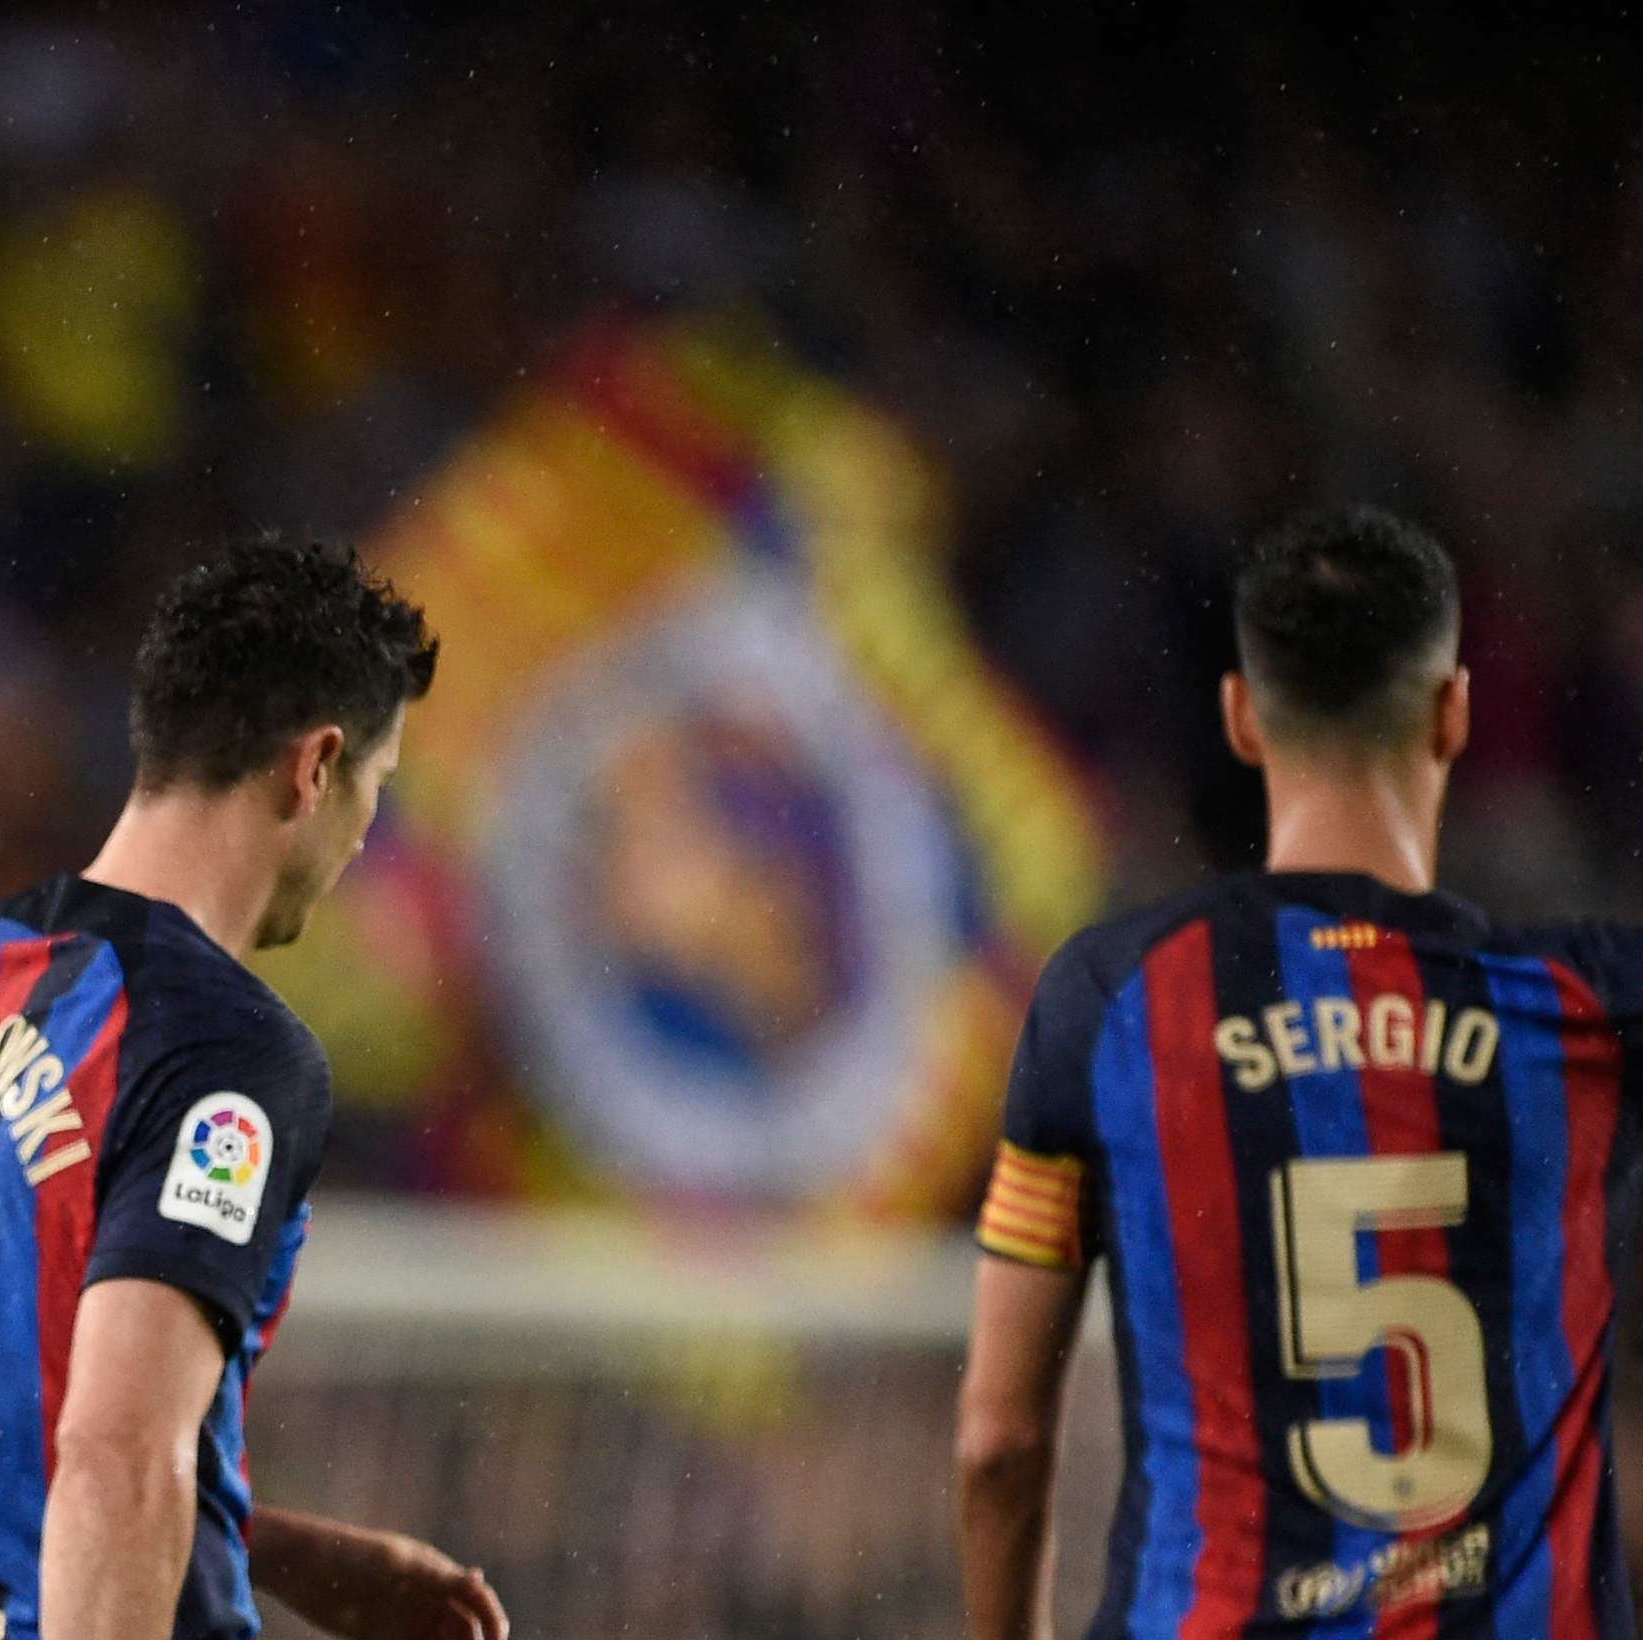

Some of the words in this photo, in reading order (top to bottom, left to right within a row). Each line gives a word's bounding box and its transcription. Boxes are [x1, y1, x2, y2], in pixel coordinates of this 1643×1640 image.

[1215, 991, 1499, 1092] SERGIO
[175, 1182, 246, 1222] LaLiga
[1272, 1152, 1492, 1532] 5
